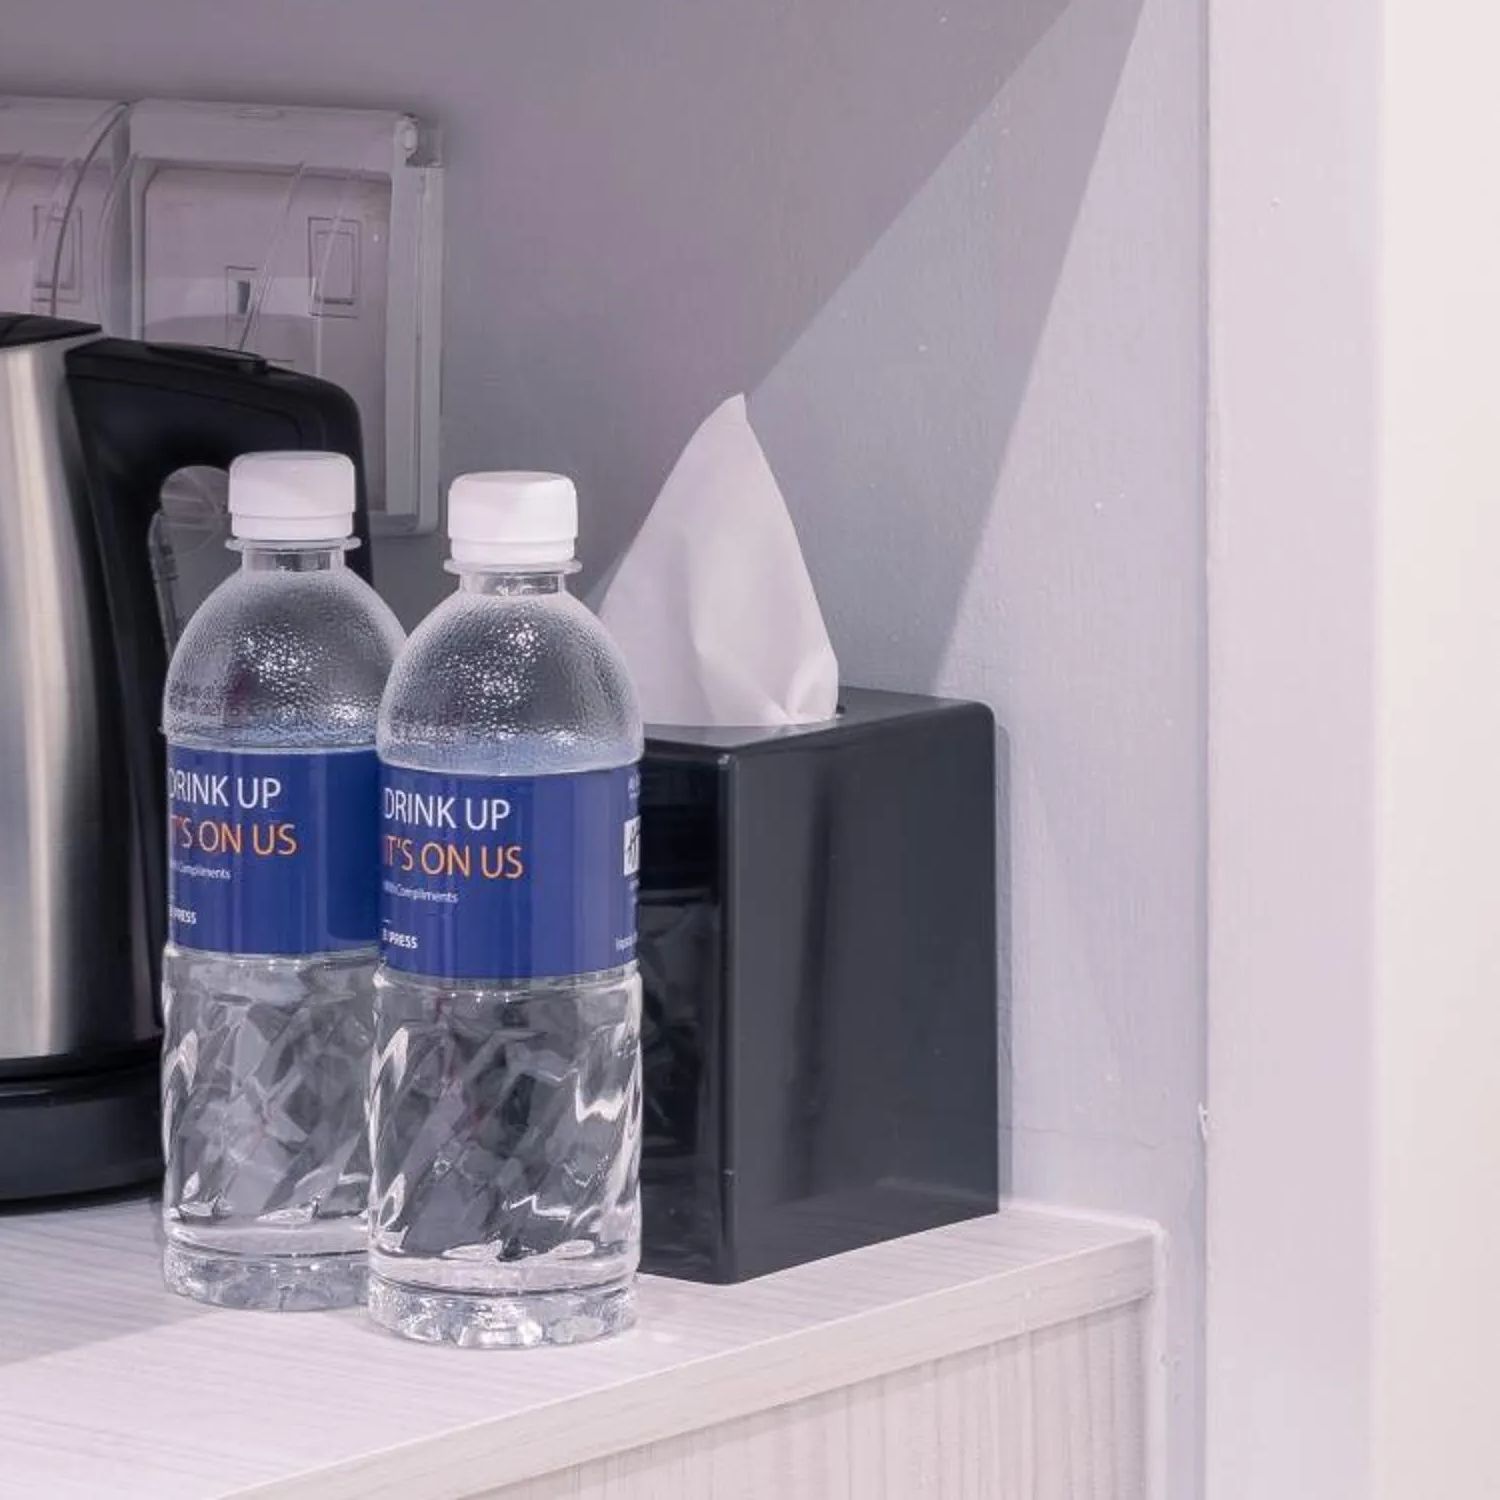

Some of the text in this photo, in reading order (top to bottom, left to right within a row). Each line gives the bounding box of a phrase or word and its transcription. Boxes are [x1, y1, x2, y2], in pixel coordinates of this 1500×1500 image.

[237, 776, 282, 809] UP
[384, 787, 511, 831] DRINK UP
[199, 820, 242, 853] ON
[252, 823, 297, 856] US
[421, 842, 470, 877] ON
[481, 845, 524, 879] US
